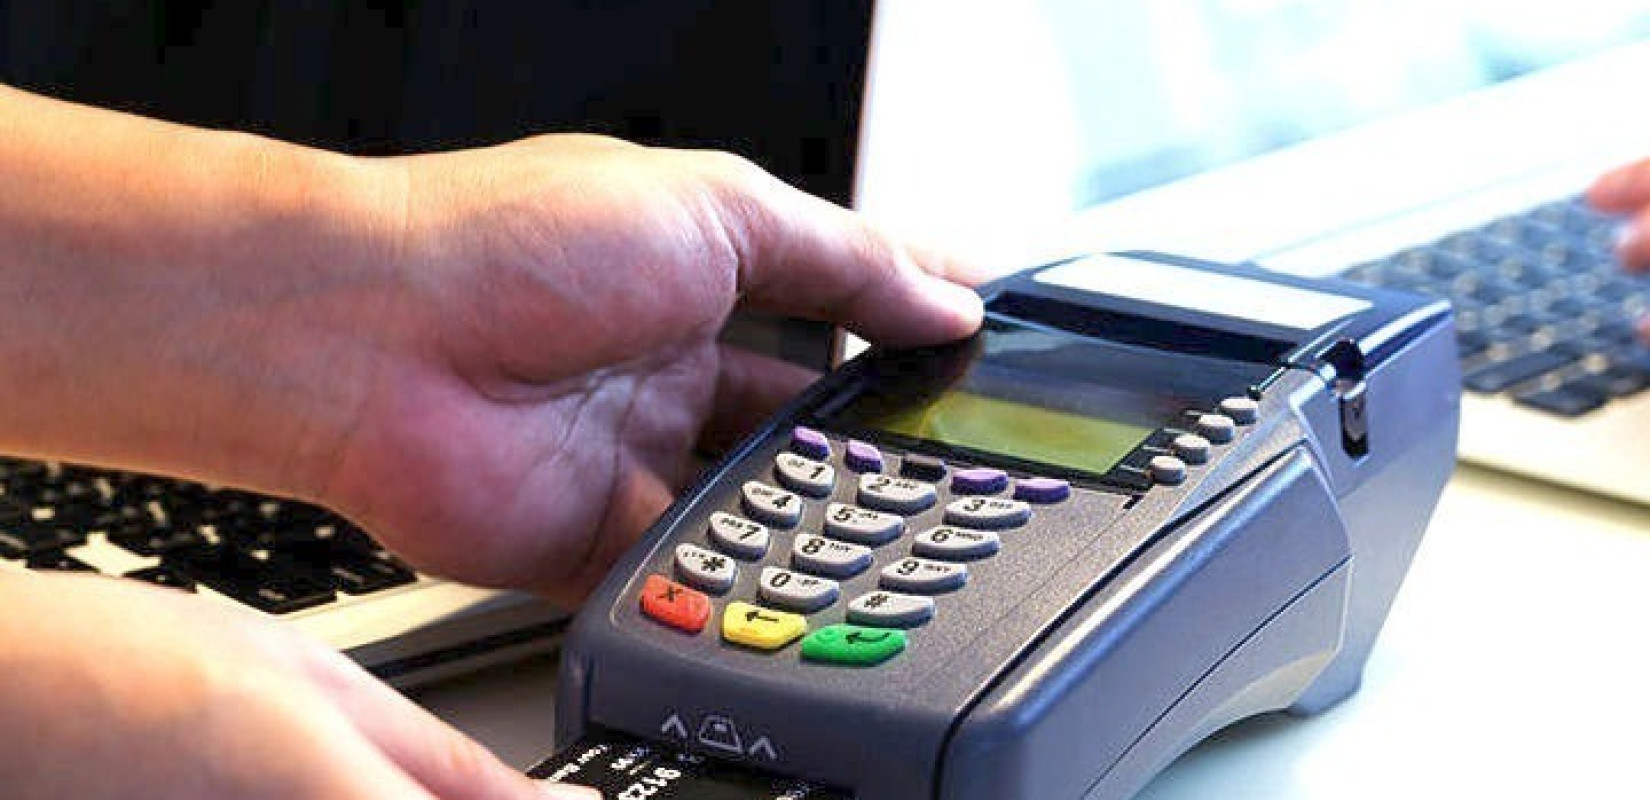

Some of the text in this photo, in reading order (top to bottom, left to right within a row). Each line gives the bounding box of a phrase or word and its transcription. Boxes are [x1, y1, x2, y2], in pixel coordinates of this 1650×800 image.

[810, 465, 825, 479] 1
[867, 478, 890, 489] 2
[772, 495, 792, 509] 4
[963, 499, 986, 511] 3
[834, 507, 855, 521] 5
[740, 525, 761, 540] 7
[930, 529, 953, 543] 6
[802, 538, 825, 553] 8
[896, 561, 919, 575] 9
[770, 572, 791, 587] 0
